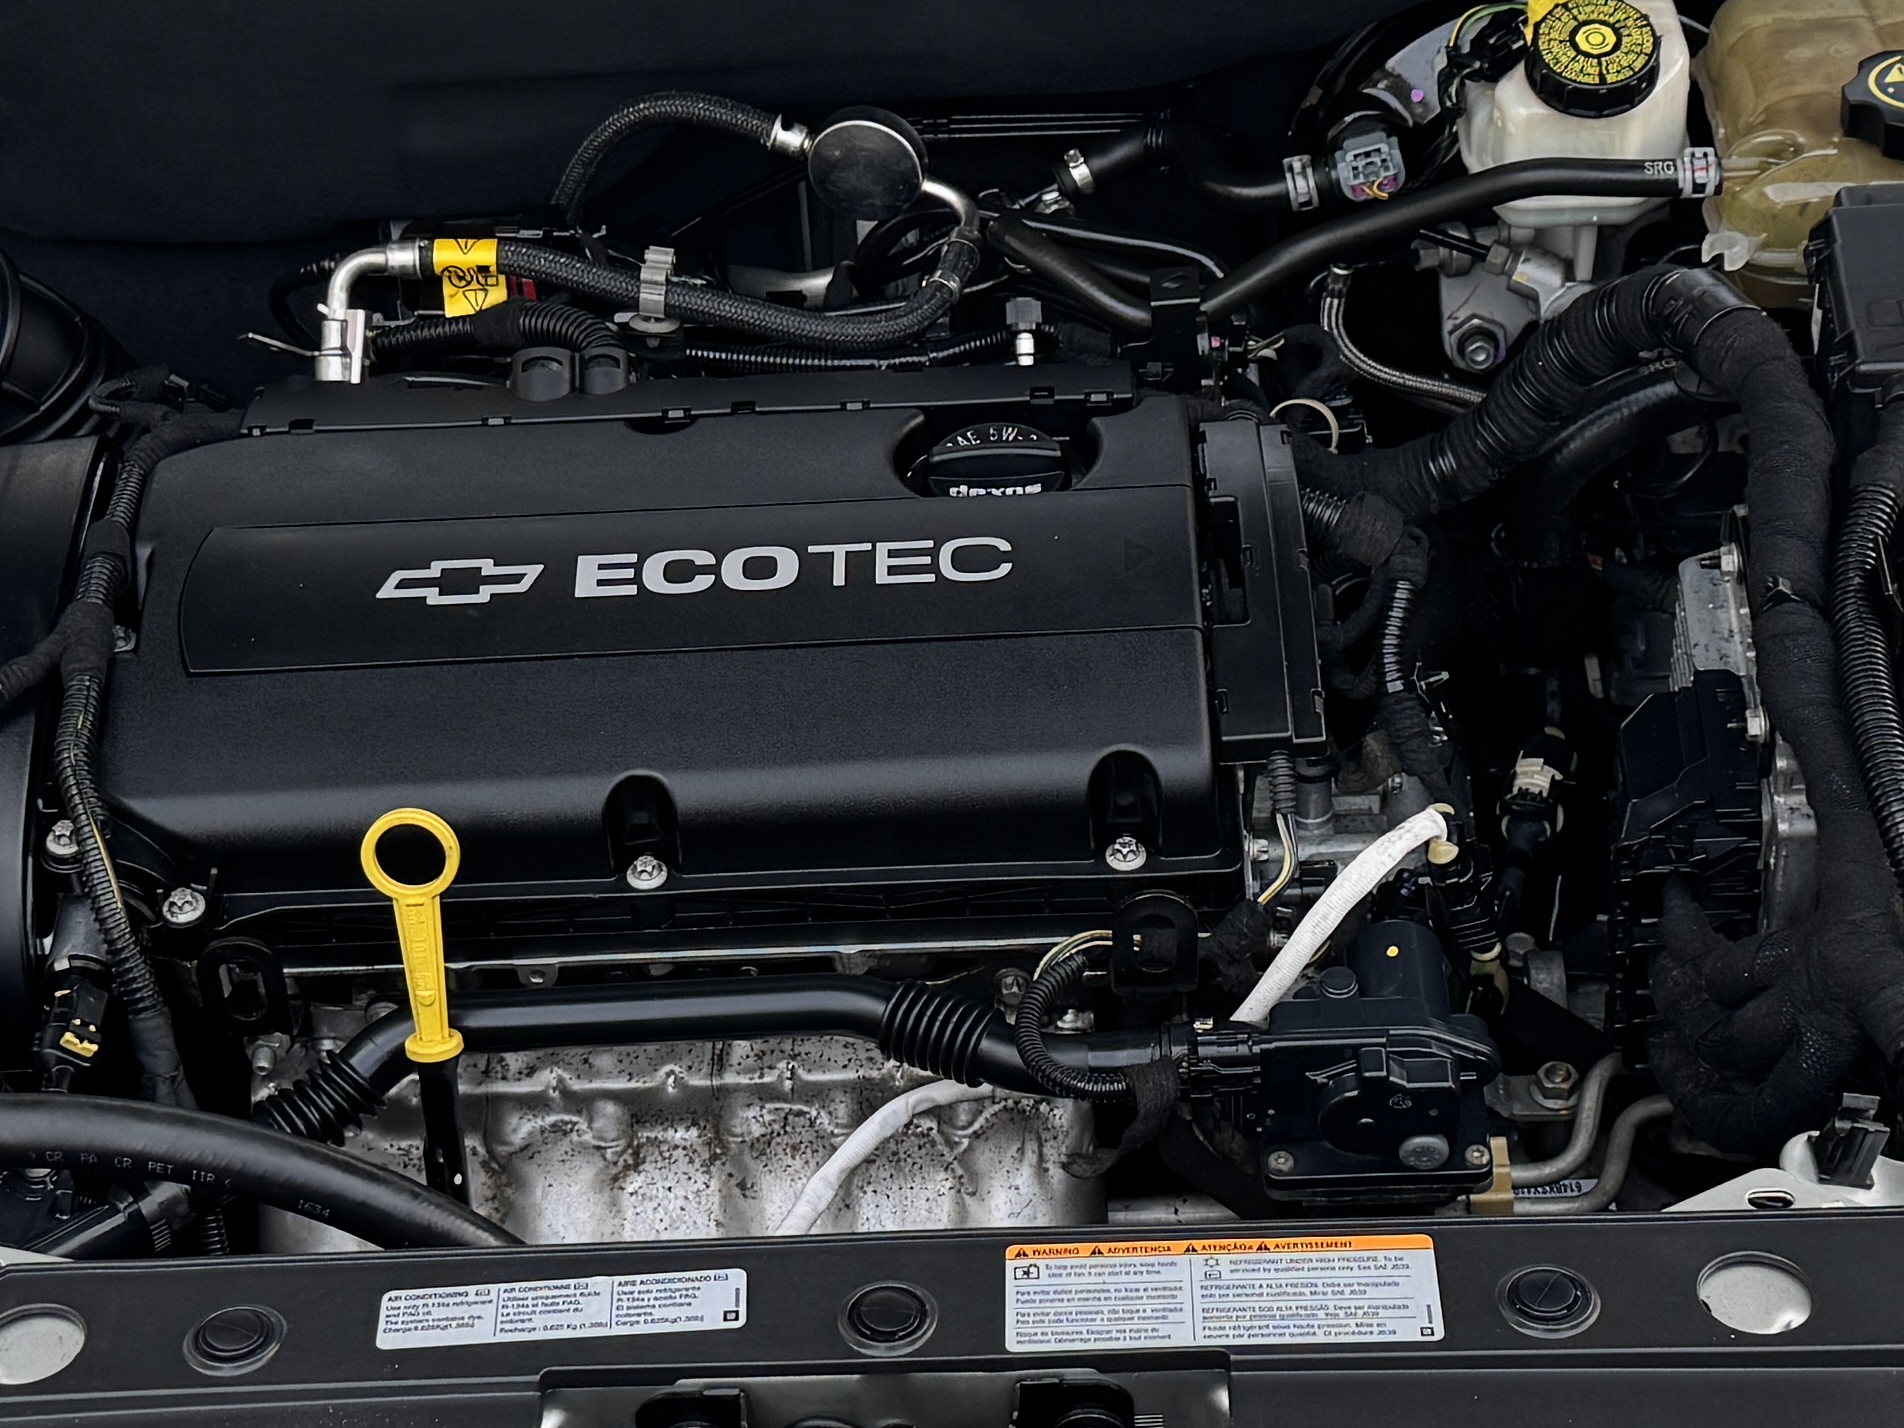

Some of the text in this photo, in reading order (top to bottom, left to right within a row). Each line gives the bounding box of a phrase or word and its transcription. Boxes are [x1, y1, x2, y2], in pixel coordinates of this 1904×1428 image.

[1644, 161, 1674, 175] SRG
[574, 535, 1014, 599] ECOTEC
[45, 1152, 215, 1184] CR PA CR PET IIR
[297, 1199, 330, 1217] 1634
[1033, 1247, 1079, 1256] WARNING
[1107, 1245, 1172, 1254] ADVERTENCIA
[1274, 1241, 1352, 1251] AVERTISSEMENT
